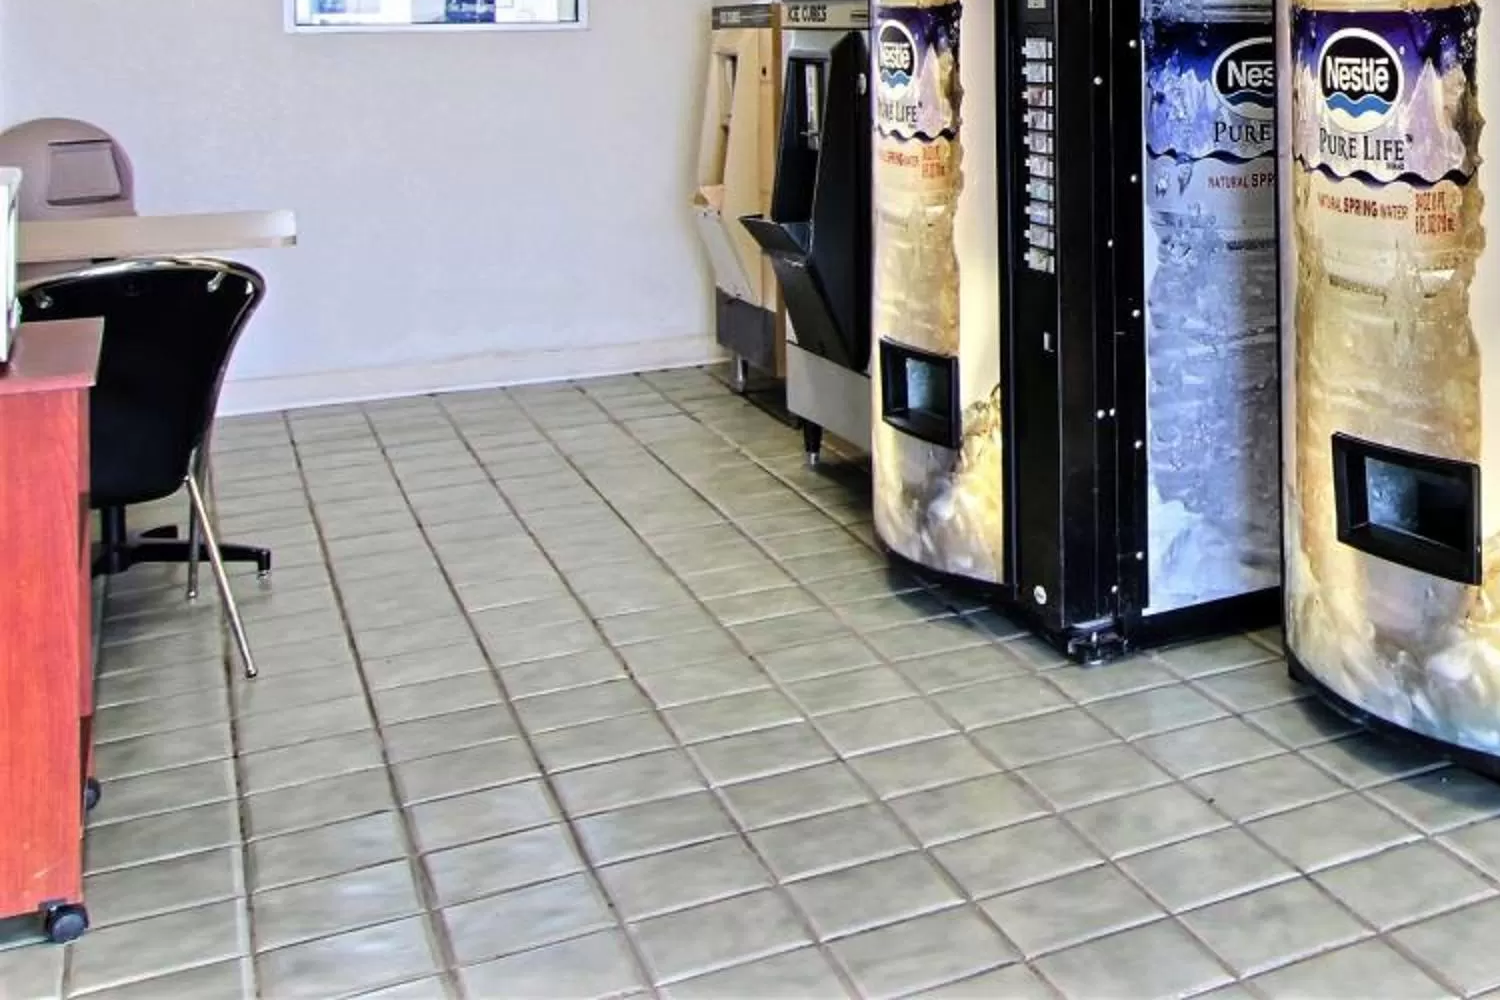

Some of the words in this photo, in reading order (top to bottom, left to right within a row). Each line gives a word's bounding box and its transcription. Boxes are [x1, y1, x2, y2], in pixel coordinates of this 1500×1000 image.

[1227, 60, 1273, 88] Nes
[1325, 55, 1390, 93] Nestlé
[1214, 121, 1271, 145] PURE
[1319, 127, 1357, 160] PURE
[1363, 134, 1405, 161] LIFE
[1208, 174, 1249, 189] NATURAL
[1251, 173, 1273, 188] SPR
[1343, 196, 1377, 218] SPRING
